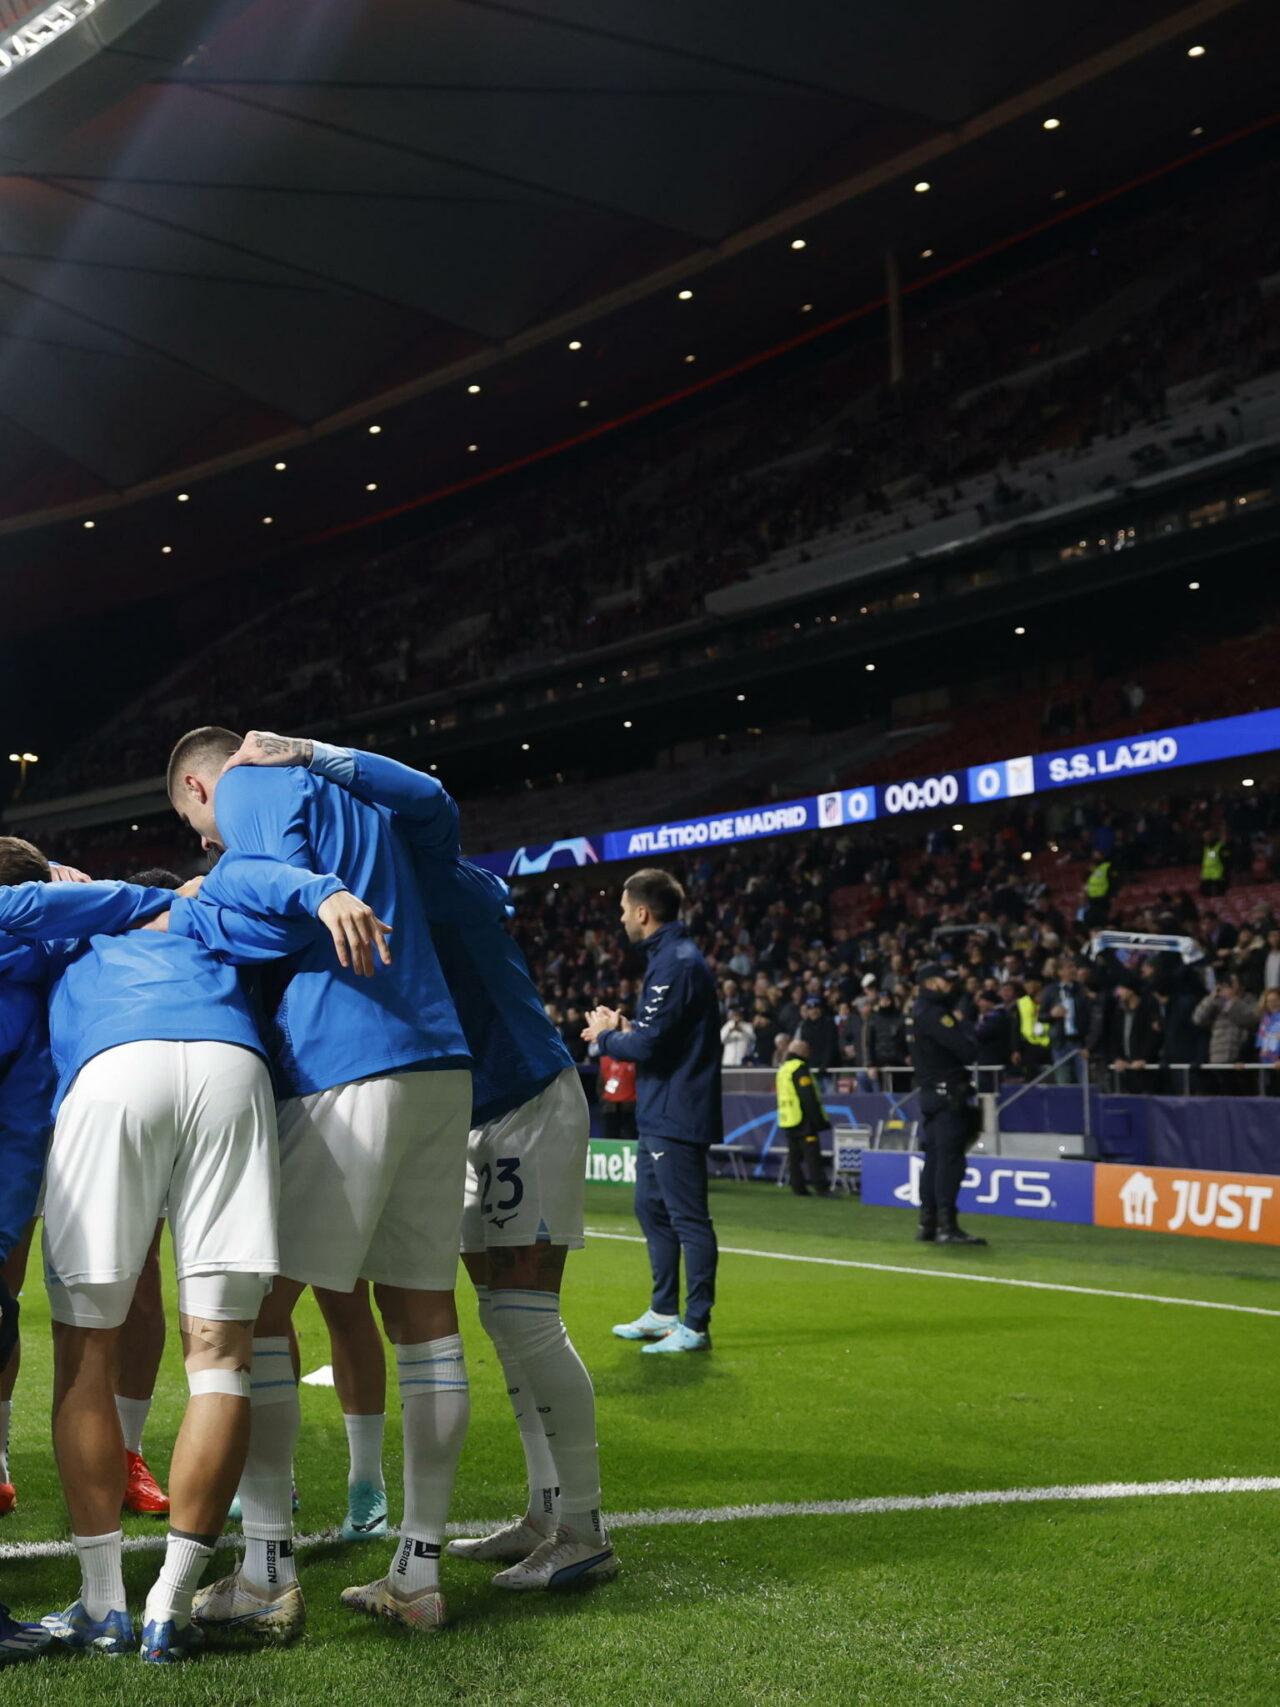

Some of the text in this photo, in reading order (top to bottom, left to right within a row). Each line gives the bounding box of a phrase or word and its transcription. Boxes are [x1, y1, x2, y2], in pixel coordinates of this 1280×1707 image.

[628, 823, 708, 853] ATLÉTICO
[710, 818, 734, 841] DE
[735, 806, 807, 836] MADRID
[847, 792, 868, 818] 0
[885, 775, 958, 813] 00:00
[977, 768, 1000, 797] 0
[1097, 737, 1178, 772] LAZIO
[584, 1143, 638, 1183] inek
[480, 1156, 524, 1214] 23
[960, 1167, 1052, 1208] PS5
[1168, 1179, 1274, 1232] JUST
[267, 1540, 277, 1583] EDESIGN
[396, 1537, 413, 1576] DESIGN
